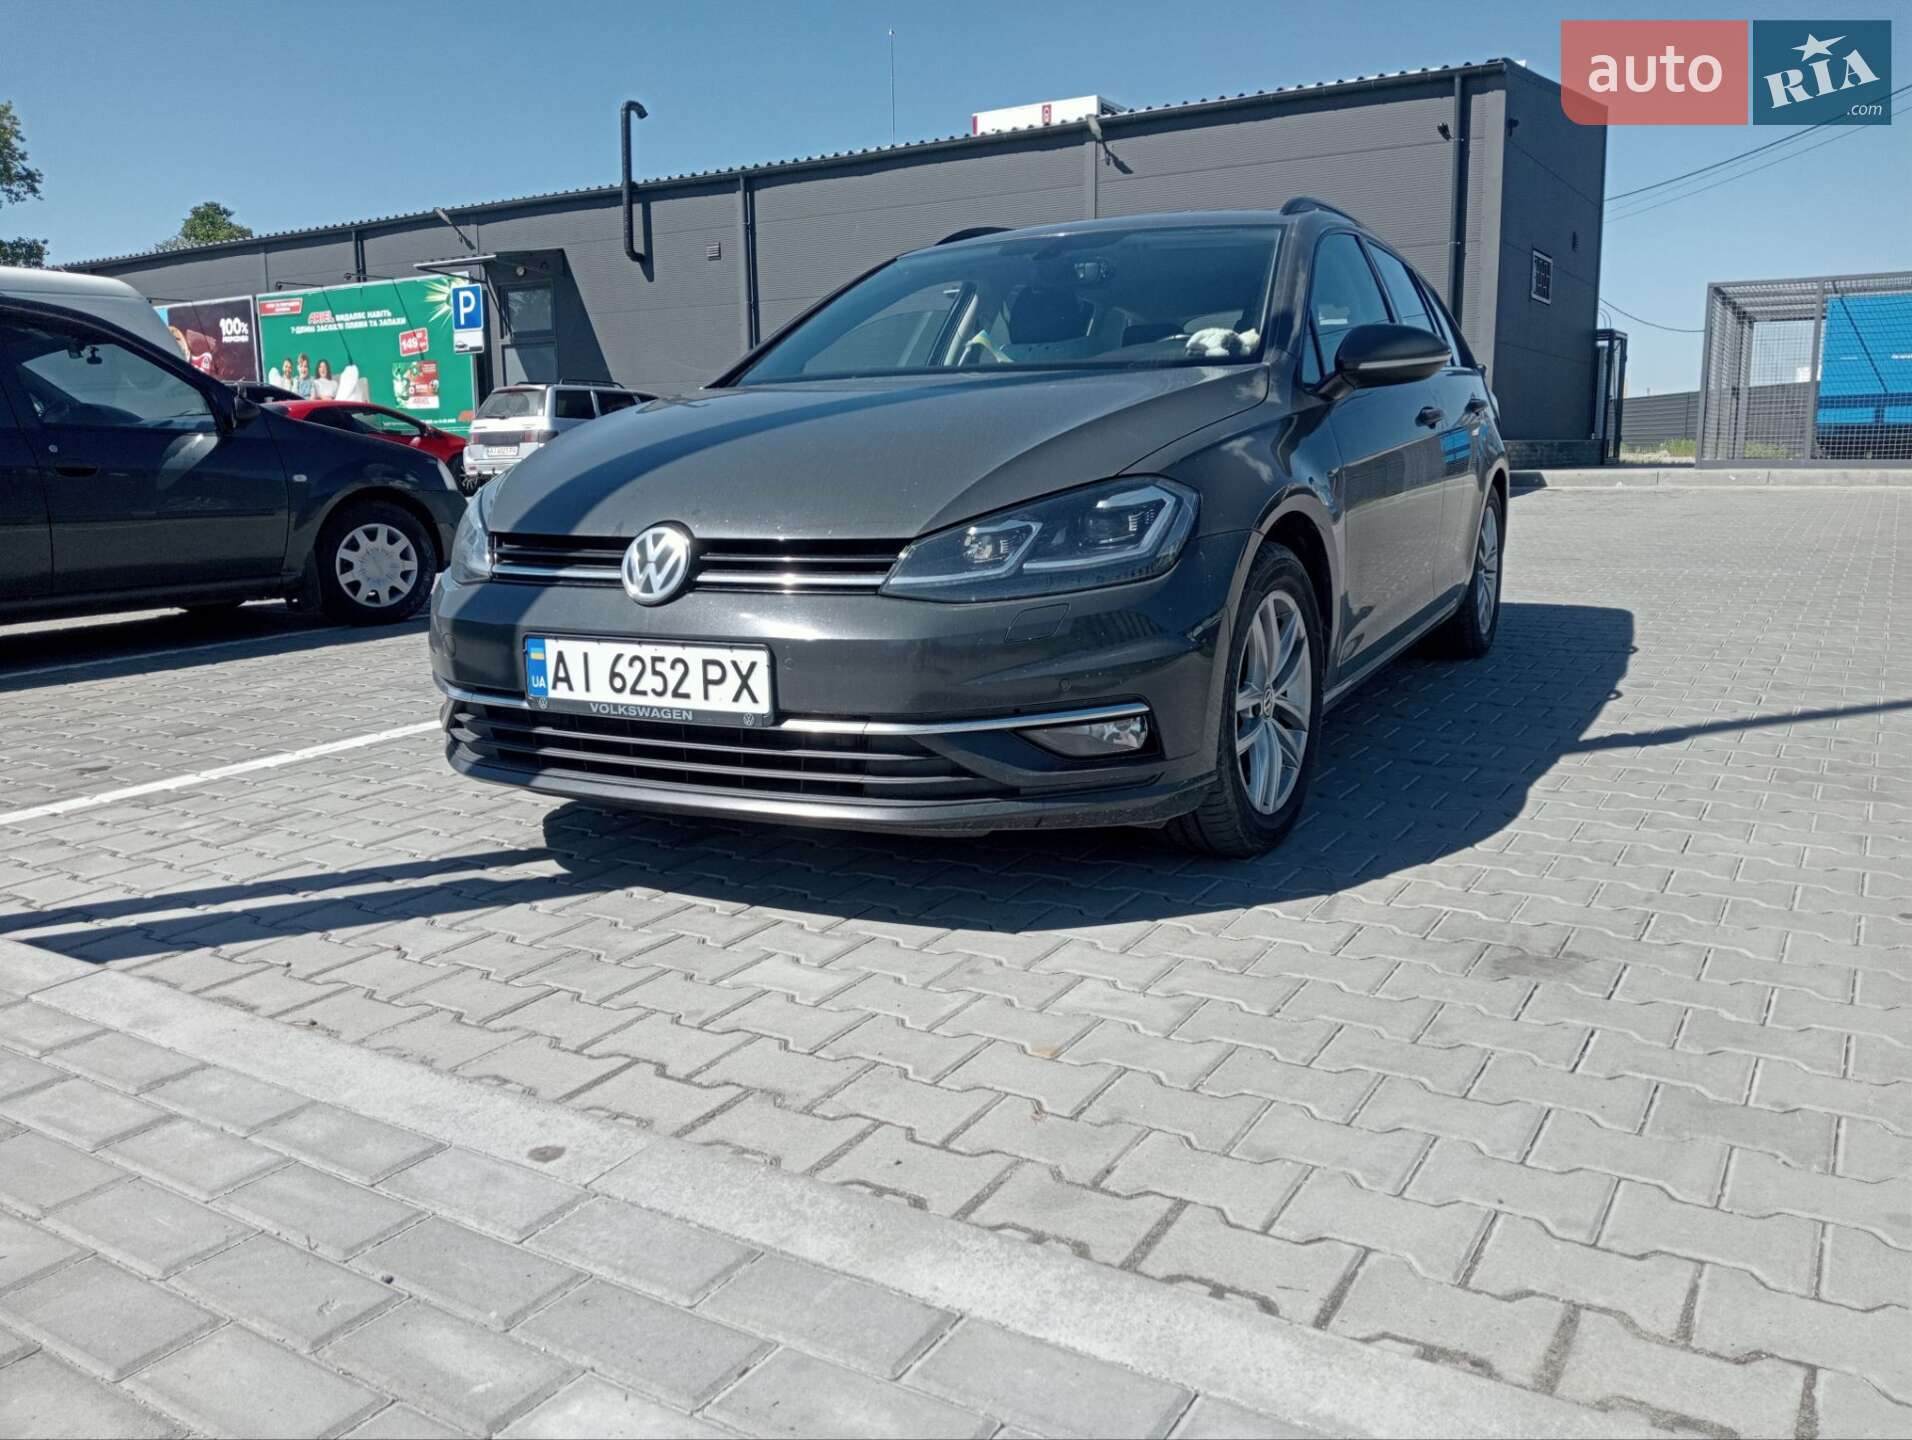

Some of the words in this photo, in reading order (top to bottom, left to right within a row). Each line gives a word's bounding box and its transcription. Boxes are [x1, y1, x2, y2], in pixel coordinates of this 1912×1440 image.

[458, 290, 476, 326] P
[219, 317, 249, 336] 100%
[531, 675, 546, 689] UA
[551, 650, 590, 693] AI
[608, 653, 691, 699] 6252
[702, 659, 759, 704] PX
[590, 703, 693, 721] VOLKSWAGEN
